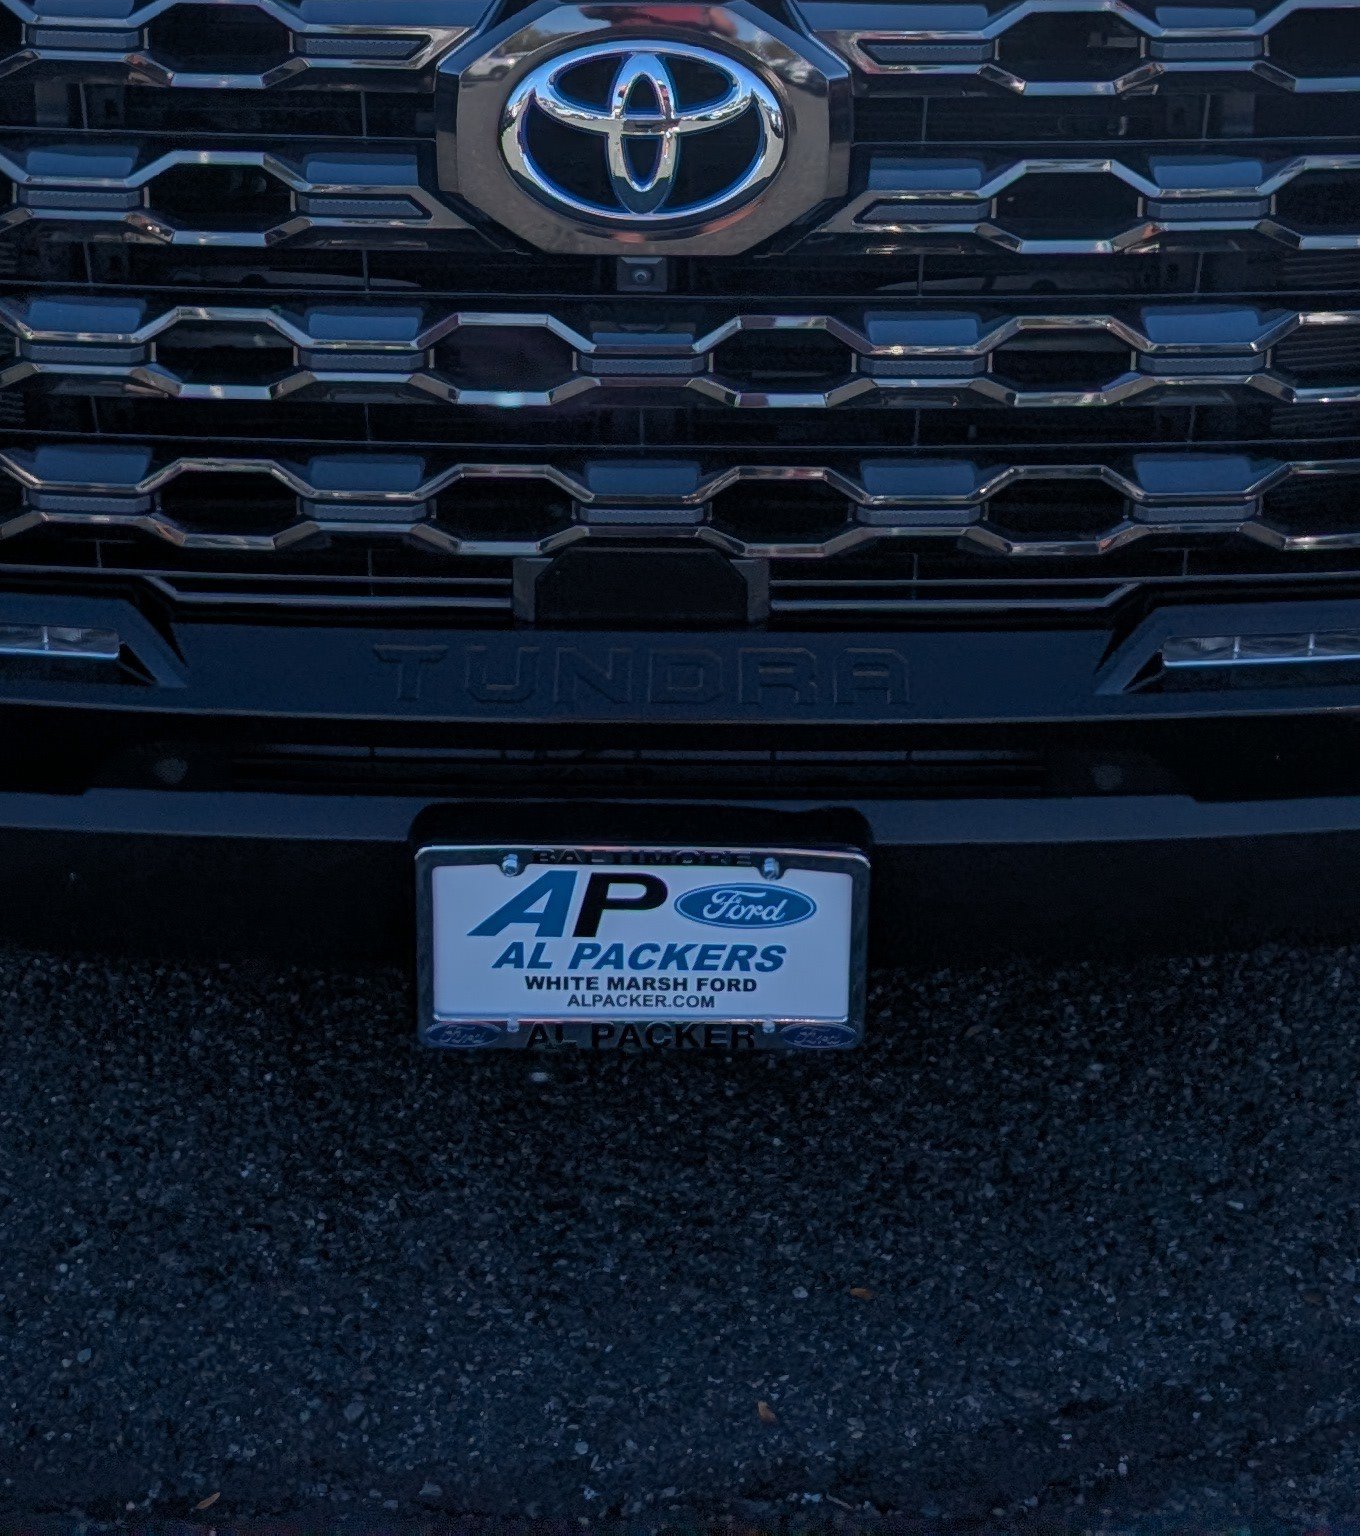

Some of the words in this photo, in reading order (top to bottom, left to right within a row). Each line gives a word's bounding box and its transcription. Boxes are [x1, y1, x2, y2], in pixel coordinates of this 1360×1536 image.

[372, 643, 913, 706] TUNDRA
[466, 869, 668, 938] AP
[702, 889, 787, 923] Ford
[491, 941, 553, 970] AL
[567, 942, 787, 973] PACKERS
[524, 975, 600, 991] WHITE
[606, 976, 692, 992] MARSH
[695, 977, 758, 993] FORD
[566, 993, 716, 1009] ALPACKER.COM
[525, 1021, 577, 1049] AL
[590, 1020, 755, 1050] PACKER
